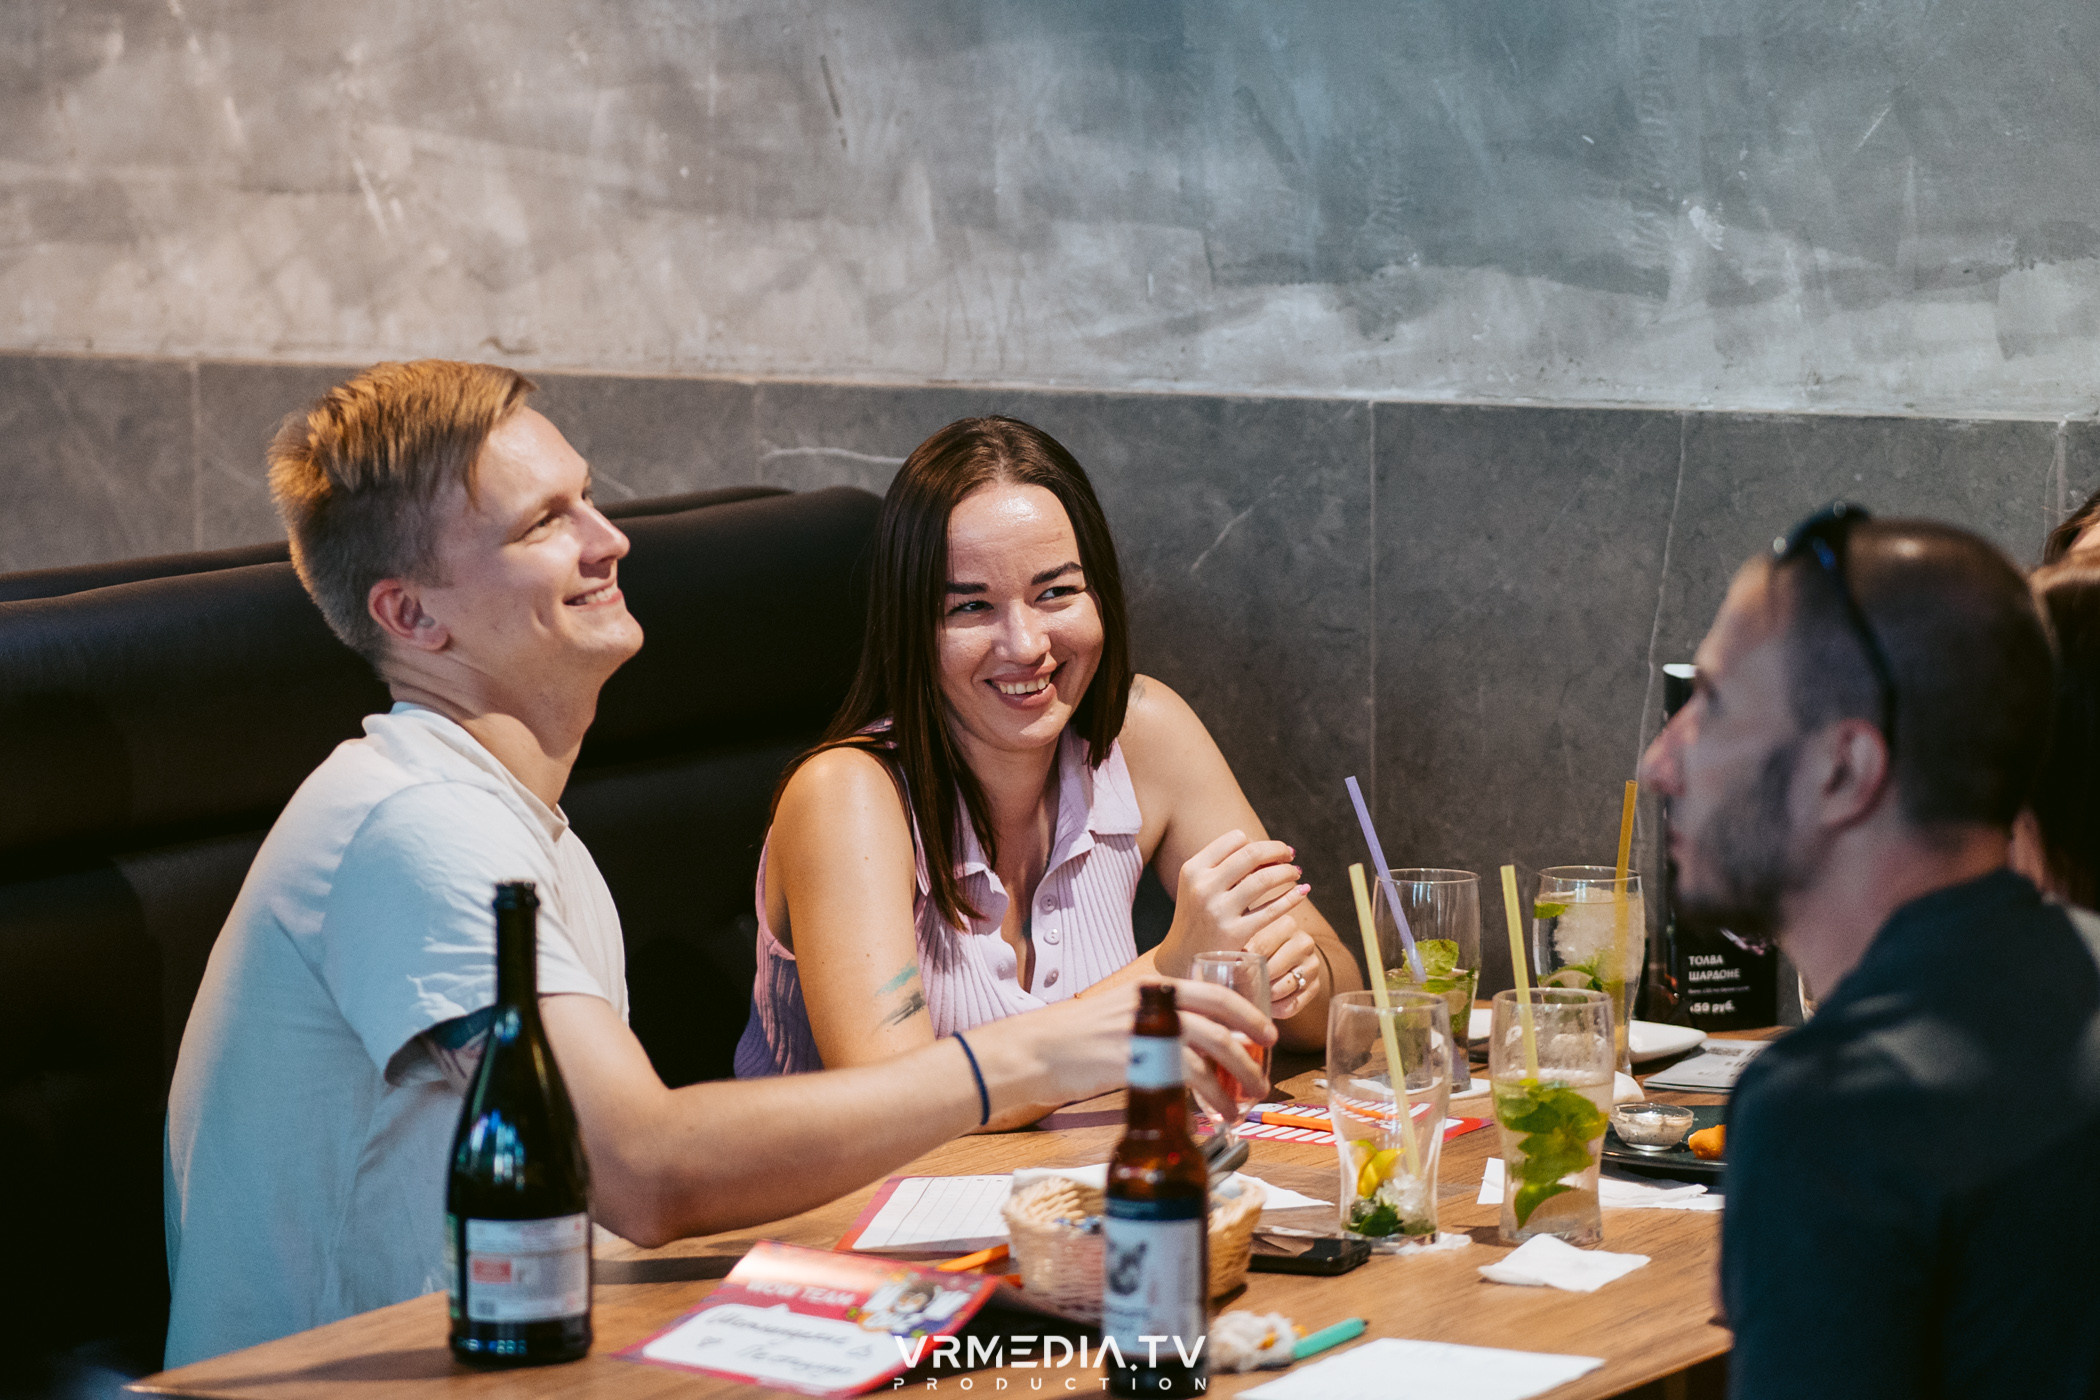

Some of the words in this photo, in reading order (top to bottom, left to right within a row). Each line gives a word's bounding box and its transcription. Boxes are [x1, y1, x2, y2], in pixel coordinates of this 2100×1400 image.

[1689, 955, 1723, 966] ТОЛВА
[1688, 968, 1740, 981] ШАРДОНЕ
[801, 1286, 856, 1305] TEAM
